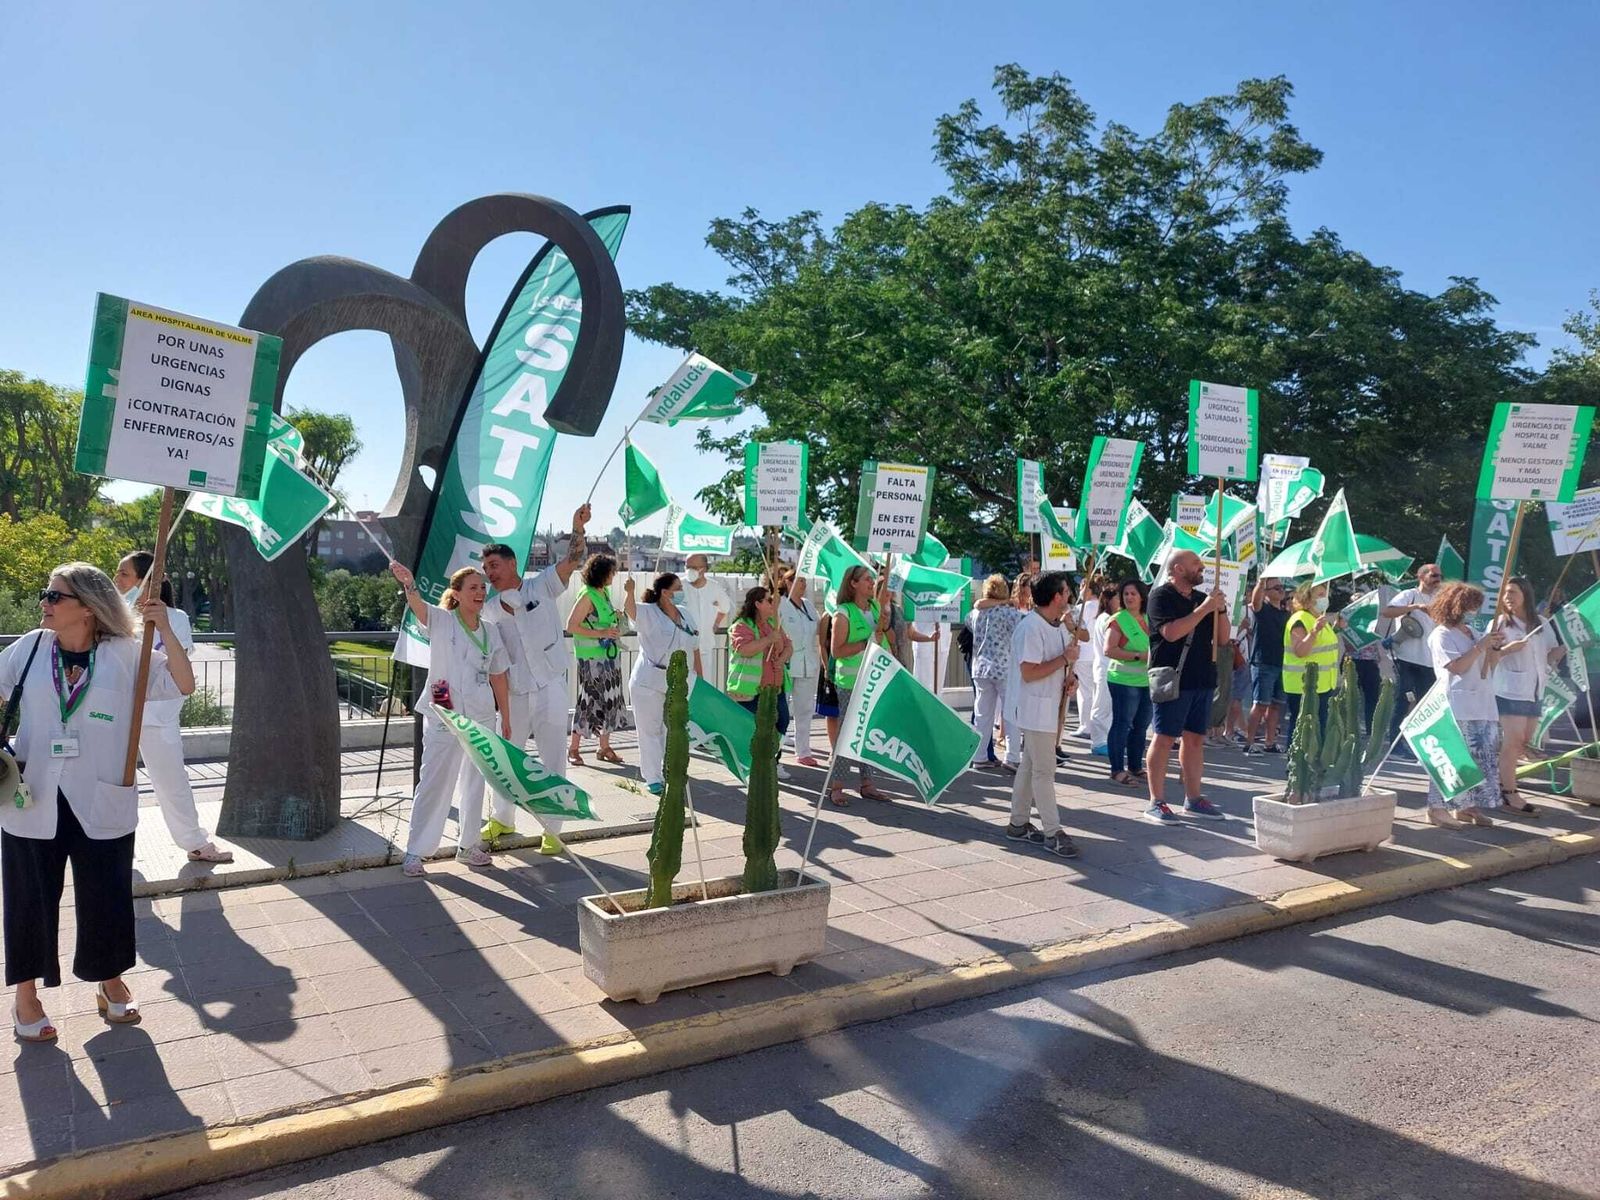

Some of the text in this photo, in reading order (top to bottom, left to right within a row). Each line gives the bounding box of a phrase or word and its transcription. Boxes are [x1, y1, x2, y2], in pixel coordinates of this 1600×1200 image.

[155, 313, 214, 335] HOSPITALARIA
[216, 330, 226, 338] DE
[226, 332, 253, 344] VALME
[157, 334, 224, 358] POR UNAS
[150, 353, 226, 379] URGENCIAS
[160, 376, 211, 396] DIGNAS
[128, 398, 236, 428] ¡CONTRATACIÓN
[1208, 404, 1239, 413] URGENCIAS
[1204, 413, 1238, 423] SATURADAS
[124, 418, 234, 448] ENFERMEROS/AS
[166, 446, 189, 460] YA!
[1200, 445, 1234, 454] SOLUCIONES
[887, 478, 916, 488] FALTA
[876, 490, 922, 502] PERSONAL
[878, 514, 915, 524] EN ESTE
[872, 528, 916, 538] HOSPITAL
[682, 534, 726, 547] SATSE
[850, 654, 892, 754] Andalucía
[89, 711, 114, 722] SATSE
[864, 728, 934, 794] SATSE
[1420, 734, 1465, 792] SATSE
